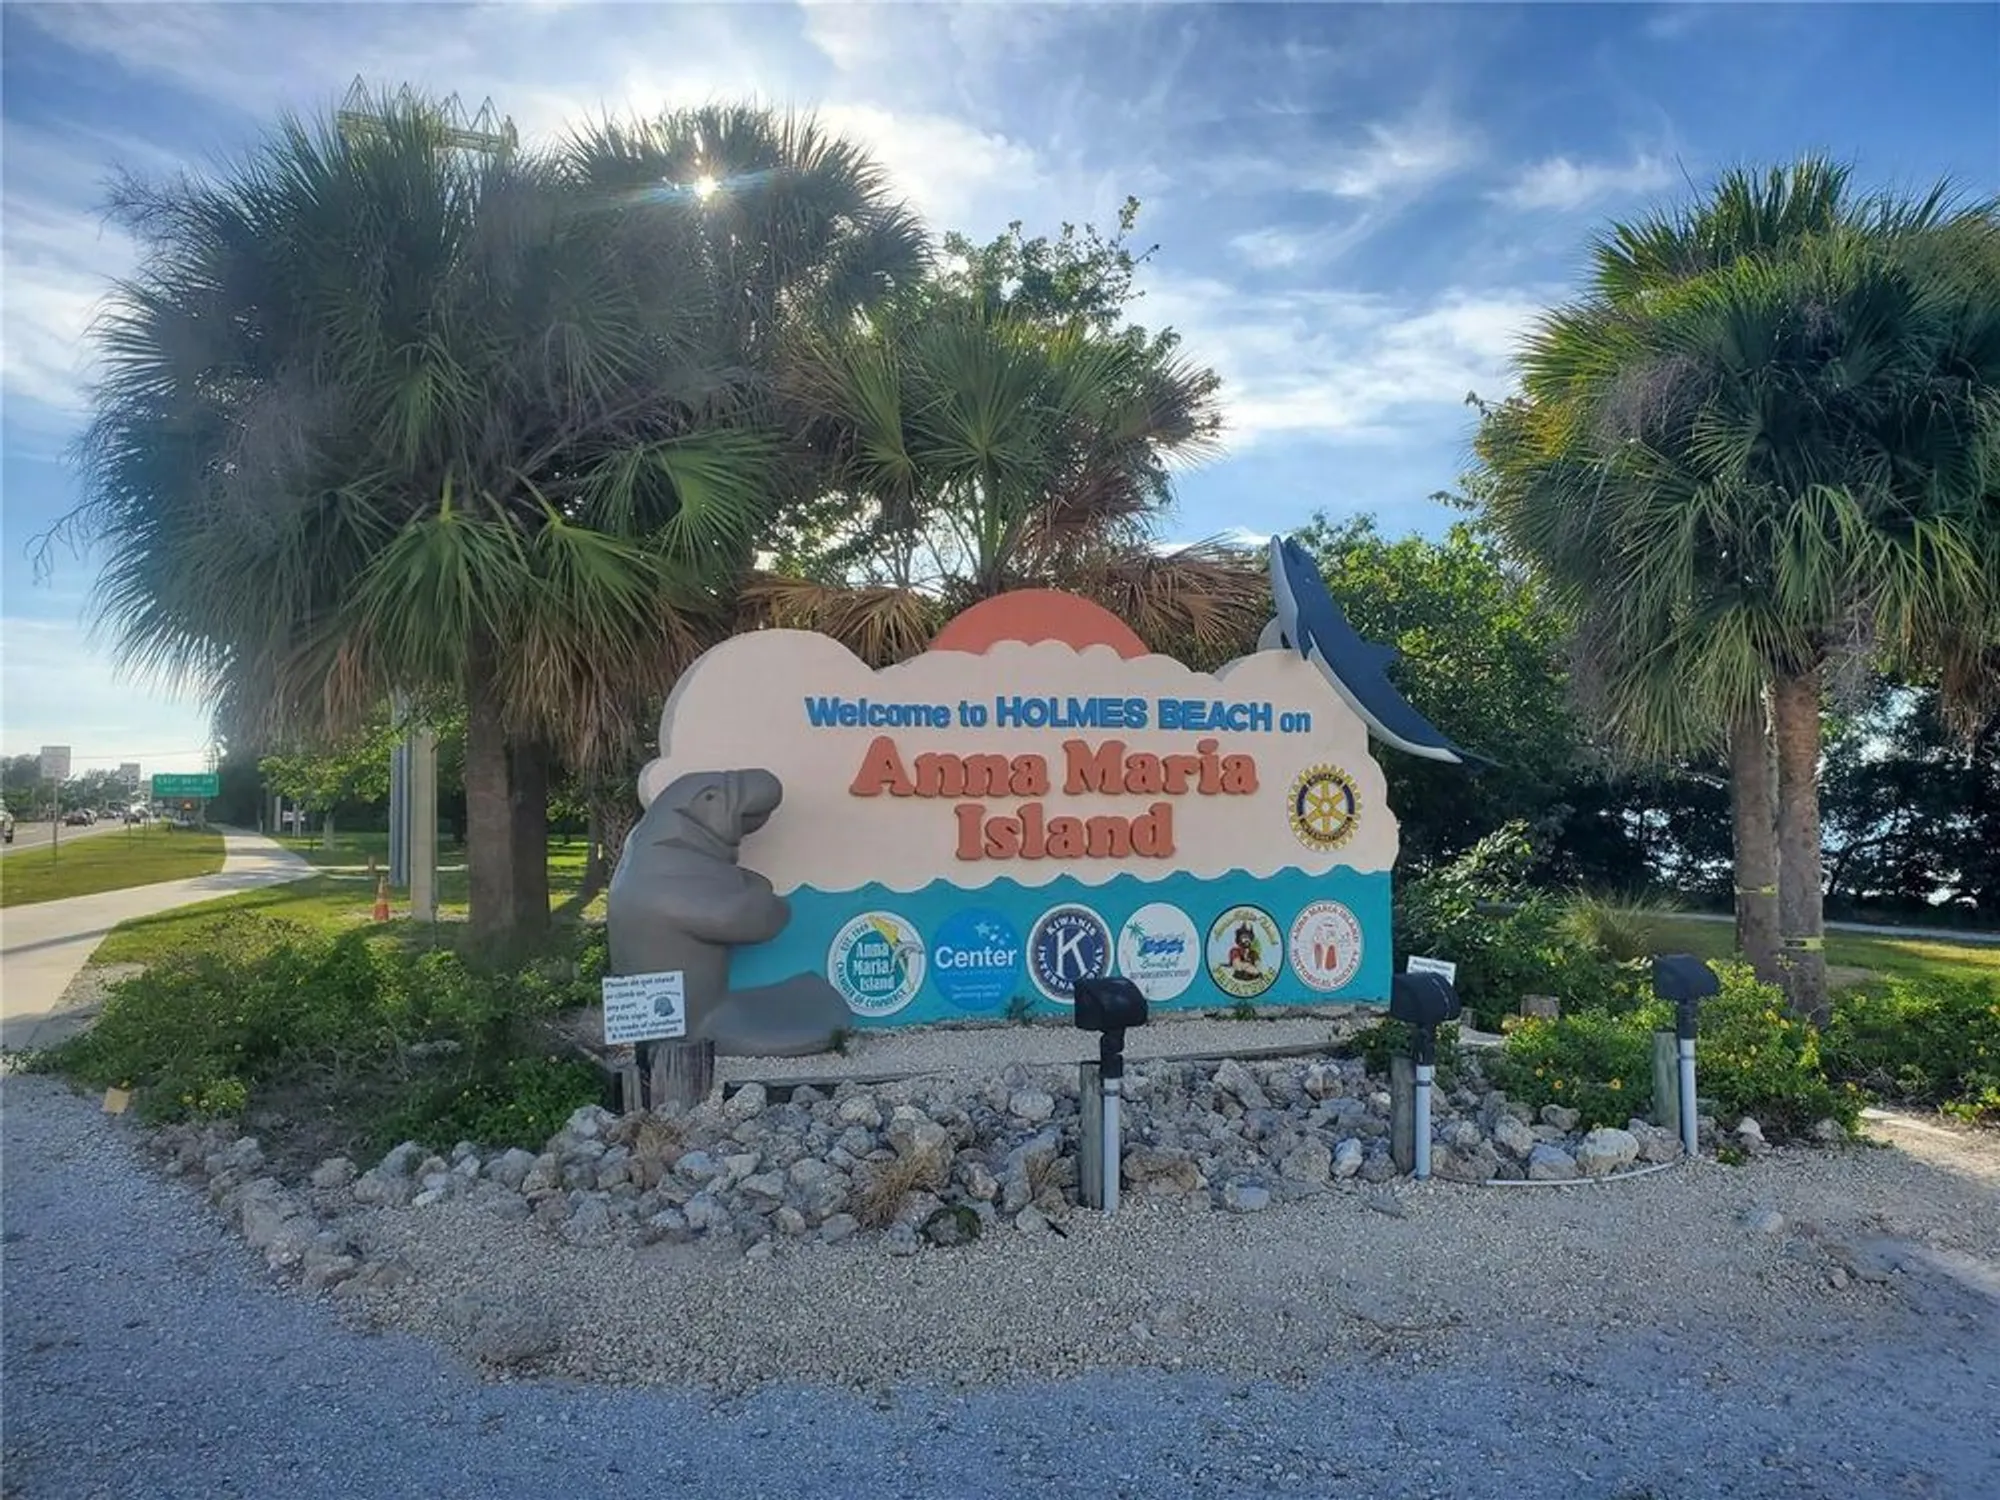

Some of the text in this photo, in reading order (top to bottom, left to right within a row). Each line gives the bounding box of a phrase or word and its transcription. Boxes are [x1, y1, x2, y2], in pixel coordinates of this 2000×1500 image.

[805, 696, 1312, 733] Welcome to HOLMES BEACH on
[849, 736, 1260, 796] Anna Maria
[954, 802, 1177, 861] Island
[1045, 915, 1097, 937] KIWANIS
[855, 941, 889, 958] Anna
[935, 945, 1018, 969] Center
[1055, 929, 1088, 982] K
[852, 959, 890, 977] Maria
[1038, 945, 1104, 992] INTERNAONAL
[860, 975, 896, 992] Island
